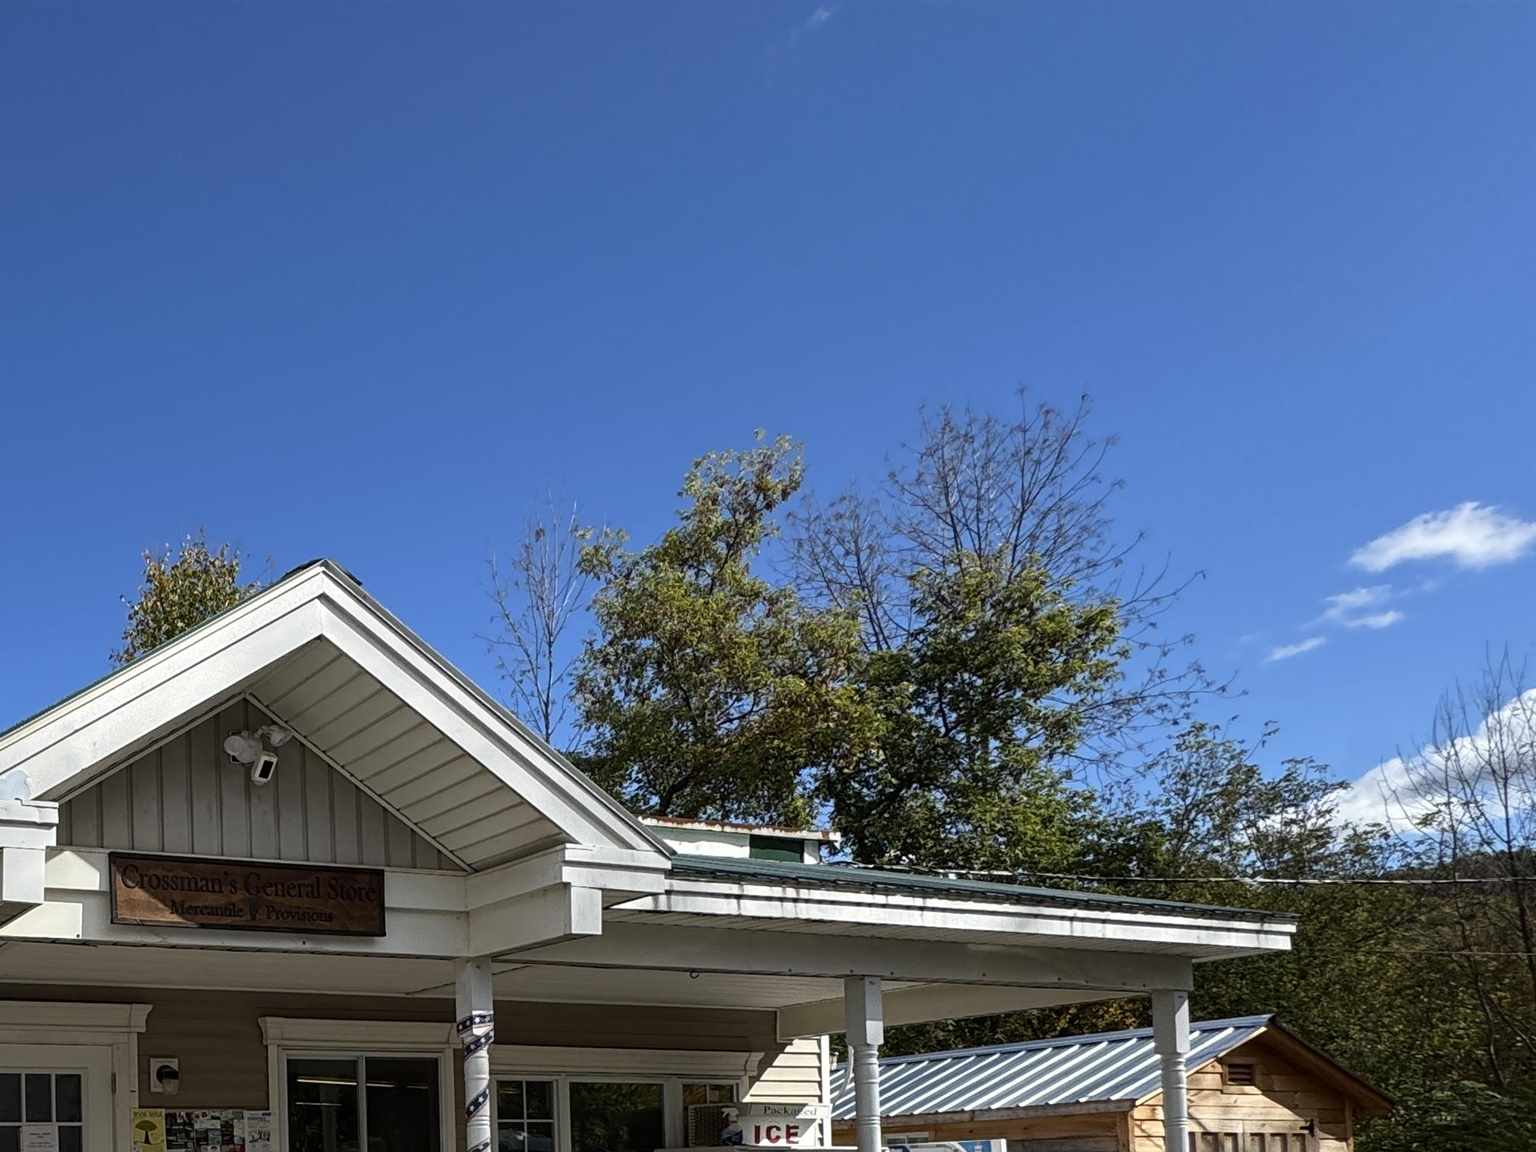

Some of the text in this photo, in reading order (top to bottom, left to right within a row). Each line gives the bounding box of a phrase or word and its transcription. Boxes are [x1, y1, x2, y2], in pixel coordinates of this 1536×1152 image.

[120, 864, 377, 902] Crossman's General Store
[169, 900, 334, 923] Mercantile Provisions
[753, 1124, 800, 1145] ICE
